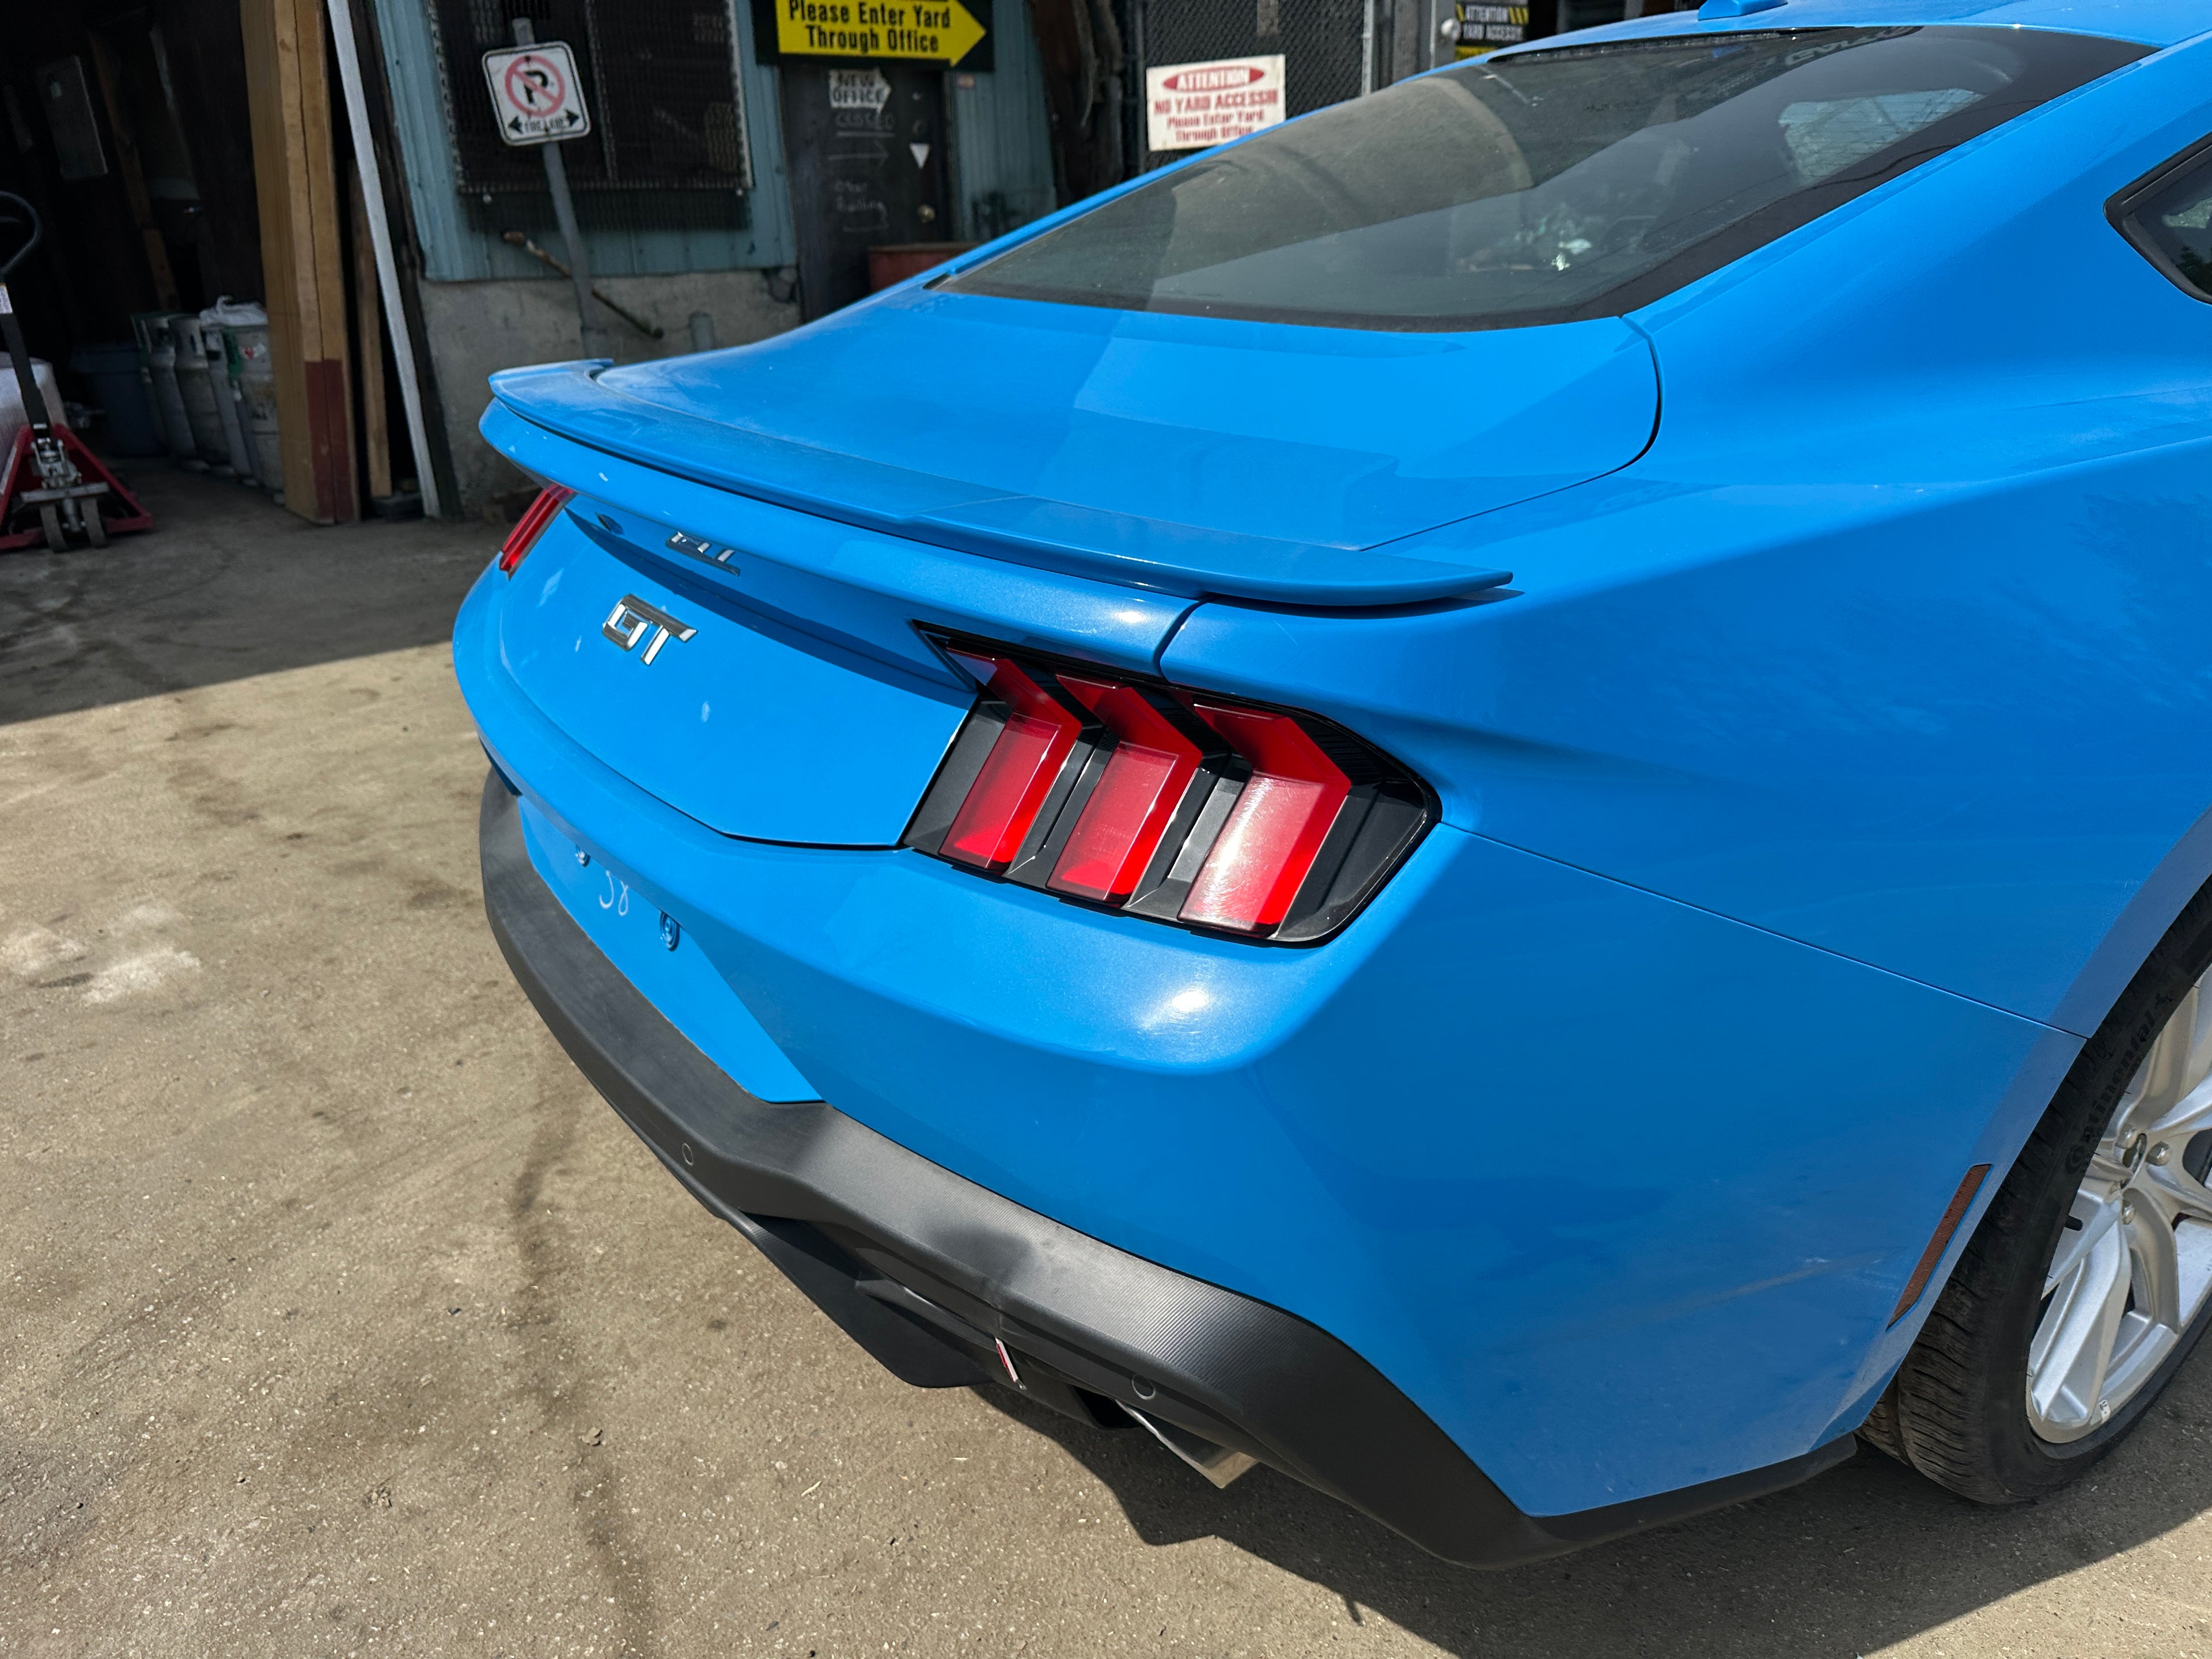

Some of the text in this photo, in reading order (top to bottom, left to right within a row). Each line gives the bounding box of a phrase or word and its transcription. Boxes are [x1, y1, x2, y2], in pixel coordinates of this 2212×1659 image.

[789, 0, 950, 28] Please Enter Yard
[805, 24, 939, 53] Through Office
[1179, 67, 1249, 90] ATTENTION
[603, 593, 698, 665] GT
